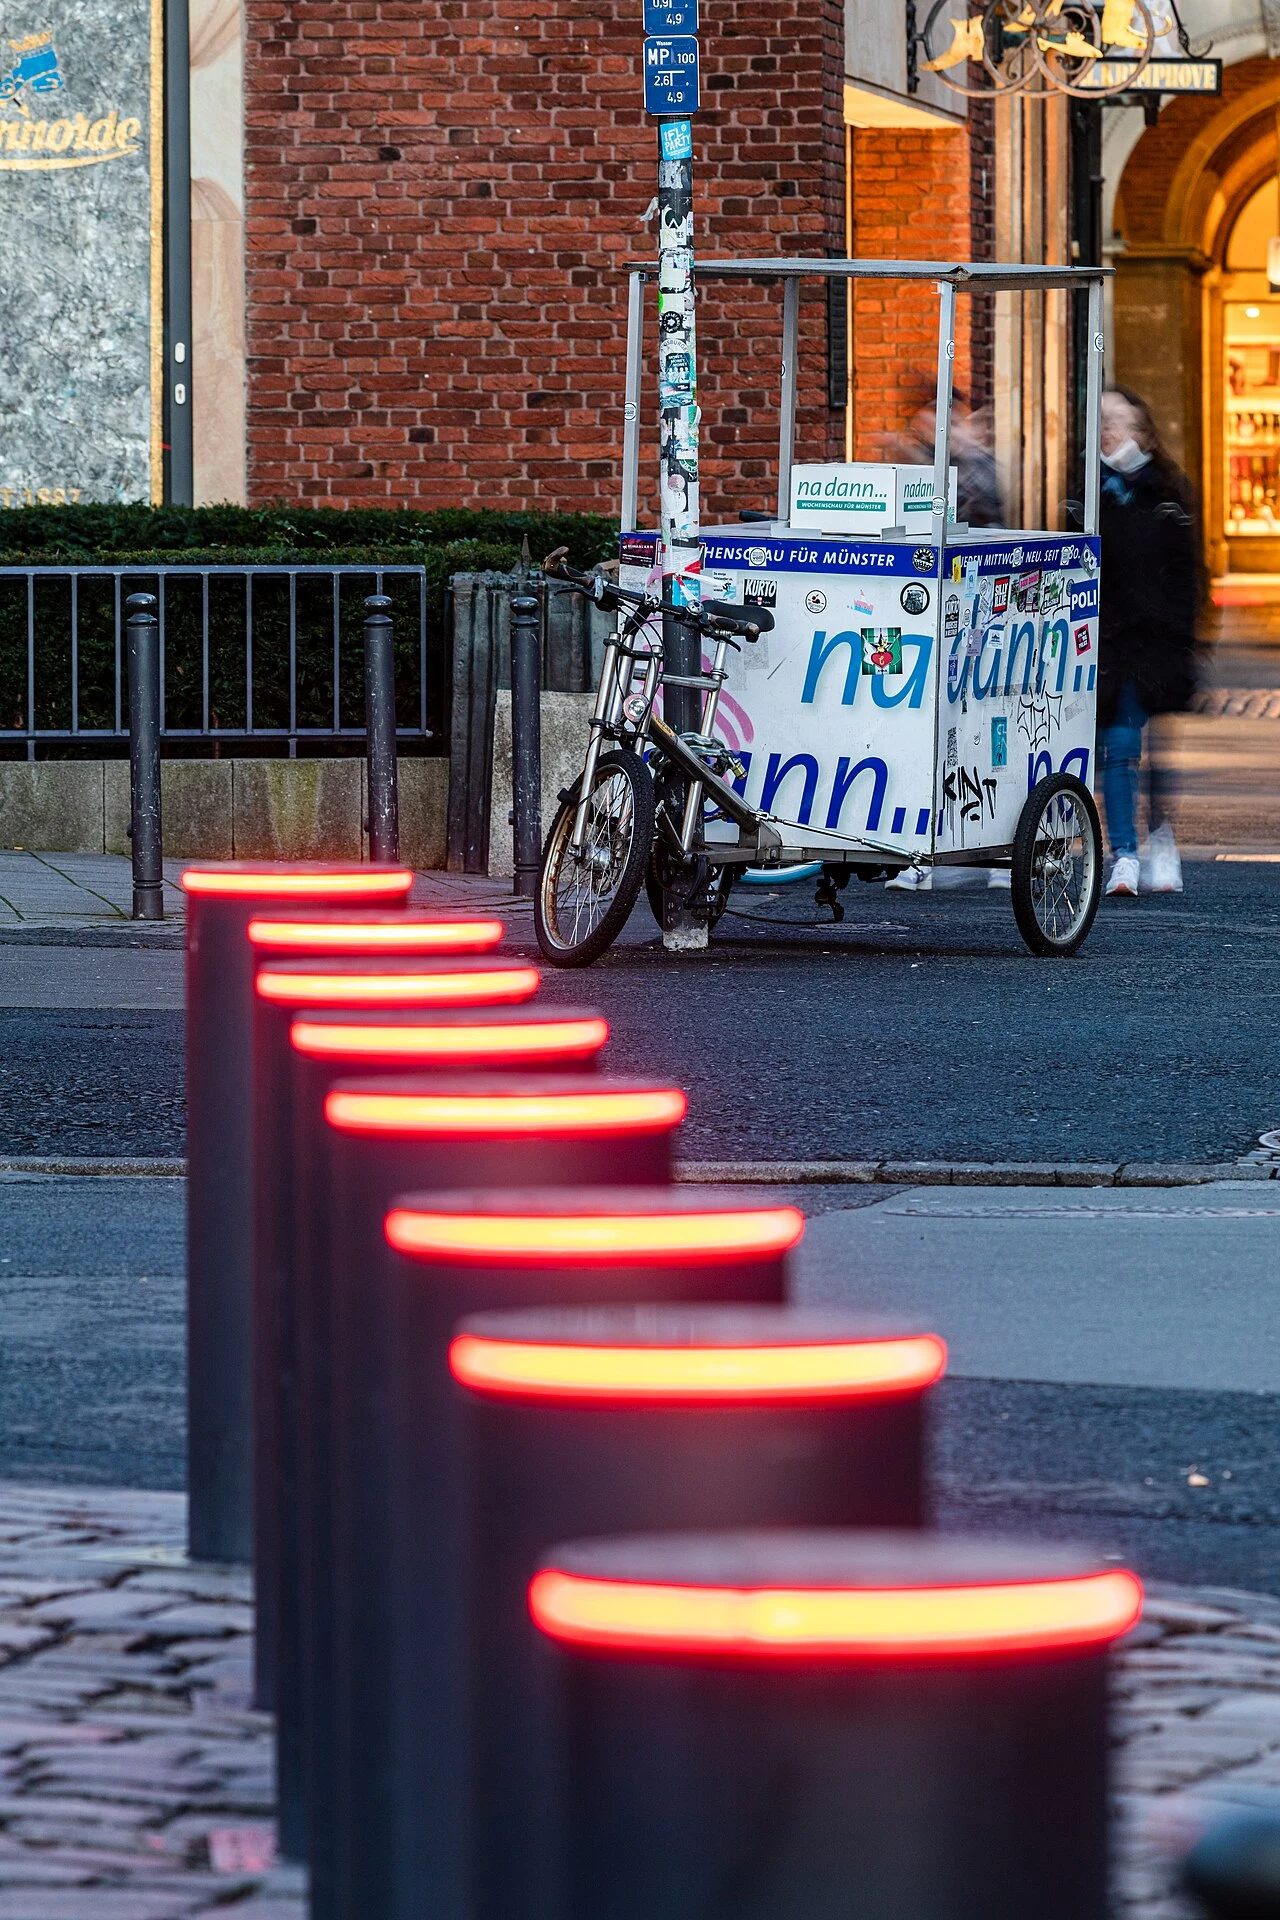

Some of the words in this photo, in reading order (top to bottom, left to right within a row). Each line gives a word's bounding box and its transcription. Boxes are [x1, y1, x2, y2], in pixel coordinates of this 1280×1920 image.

[666, 13, 682, 25] 4,9
[648, 48, 670, 65] MP
[677, 53, 696, 64] 100
[654, 75, 670, 87] 2,6
[666, 92, 683, 103] 4,9
[789, 547, 818, 564] FÜR
[823, 548, 895, 567] MÜNSTER
[983, 551, 1025, 567] MITTWOH
[1025, 550, 1042, 563] NEU.
[1044, 549, 1060, 562] SEIT
[745, 579, 777, 598] KURTO
[1071, 589, 1097, 610] POLI
[800, 630, 934, 709] na
